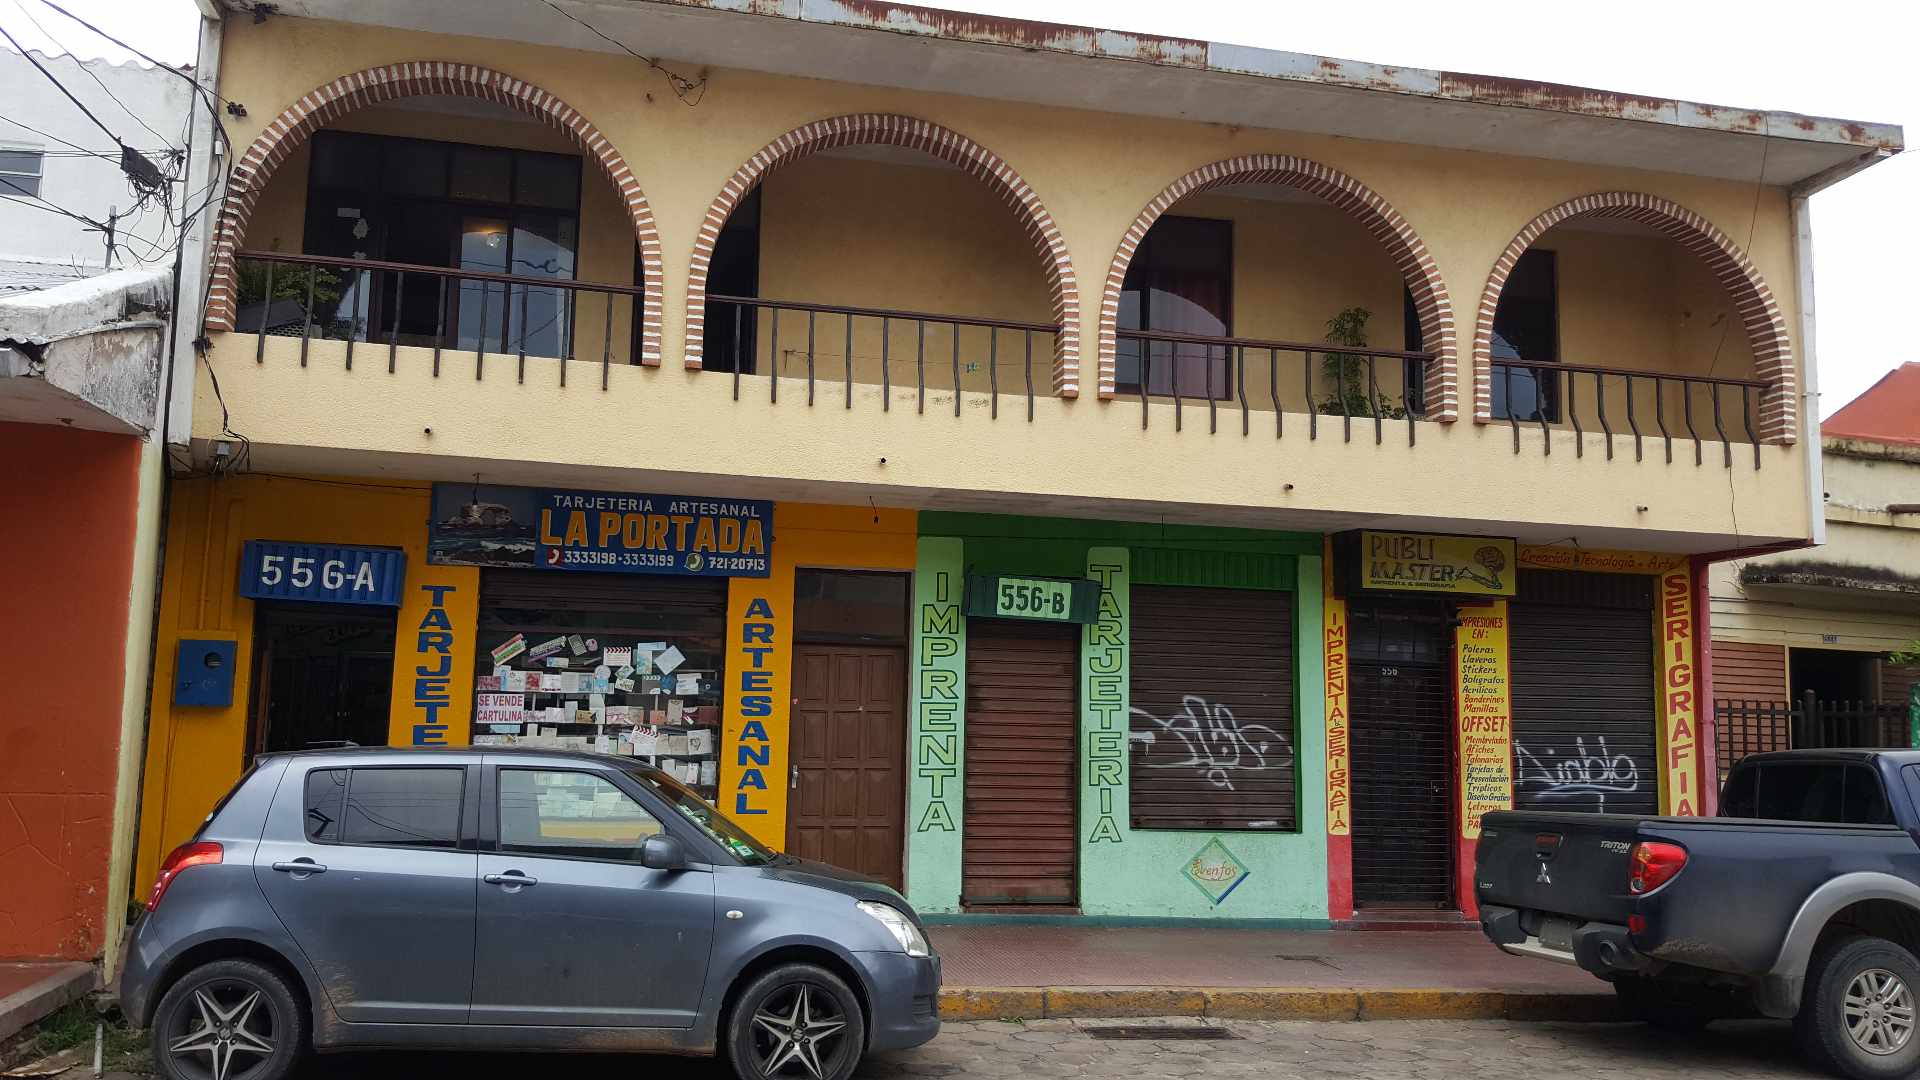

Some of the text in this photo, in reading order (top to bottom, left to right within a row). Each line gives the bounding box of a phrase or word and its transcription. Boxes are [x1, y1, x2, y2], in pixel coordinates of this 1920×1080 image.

[554, 495, 760, 517] TARJETERIA ARTESANAL
[540, 508, 765, 554] LA PORTADA
[1371, 535, 1435, 560] PUBLI
[1370, 560, 1455, 581] MASTER
[1001, 584, 1065, 615] 556-B
[1463, 643, 1495, 653] Poleras
[1327, 613, 1345, 720] IMPRENTA
[1462, 654, 1497, 663] Llaveros
[1461, 665, 1497, 673] Stickers
[479, 695, 523, 706] SE VENDE
[736, 598, 775, 814] ARTESANAL
[917, 572, 959, 832] IMPRENTA
[1089, 564, 1123, 843] TARJETERIA
[1464, 703, 1498, 712] Manillas
[477, 710, 522, 721] CARTULINA
[1462, 716, 1507, 732] OFFSET
[1466, 744, 1495, 753] Afiches
[1464, 763, 1504, 773] Tarjetas de
[1328, 727, 1347, 831] SERIGRAFIA
[1600, 841, 1631, 850] TRITON
